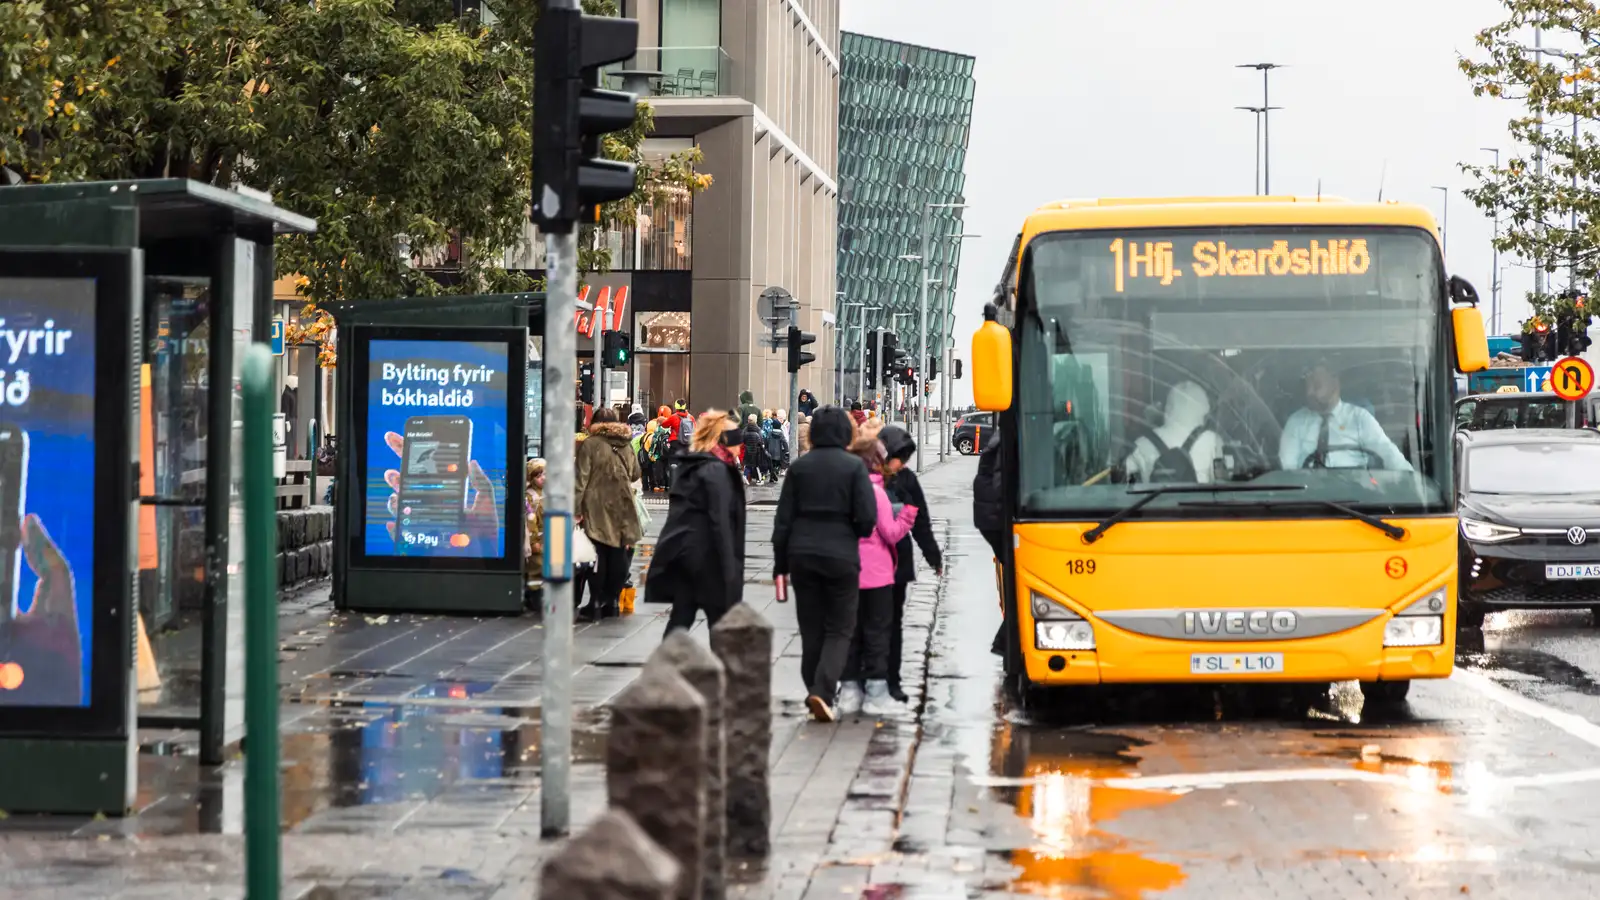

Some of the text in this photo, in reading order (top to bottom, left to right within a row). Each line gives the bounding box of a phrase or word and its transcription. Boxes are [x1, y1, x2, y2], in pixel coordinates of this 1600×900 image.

[1109, 237, 1124, 292] 1
[382, 362, 495, 387] Bylting fyrir
[381, 387, 474, 407] bókhaldið
[417, 532, 439, 547] Pay
[1065, 559, 1096, 575] 189
[1557, 566, 1574, 577] DJ
[1184, 610, 1297, 635] IVECO
[1206, 656, 1275, 671] SL L10
